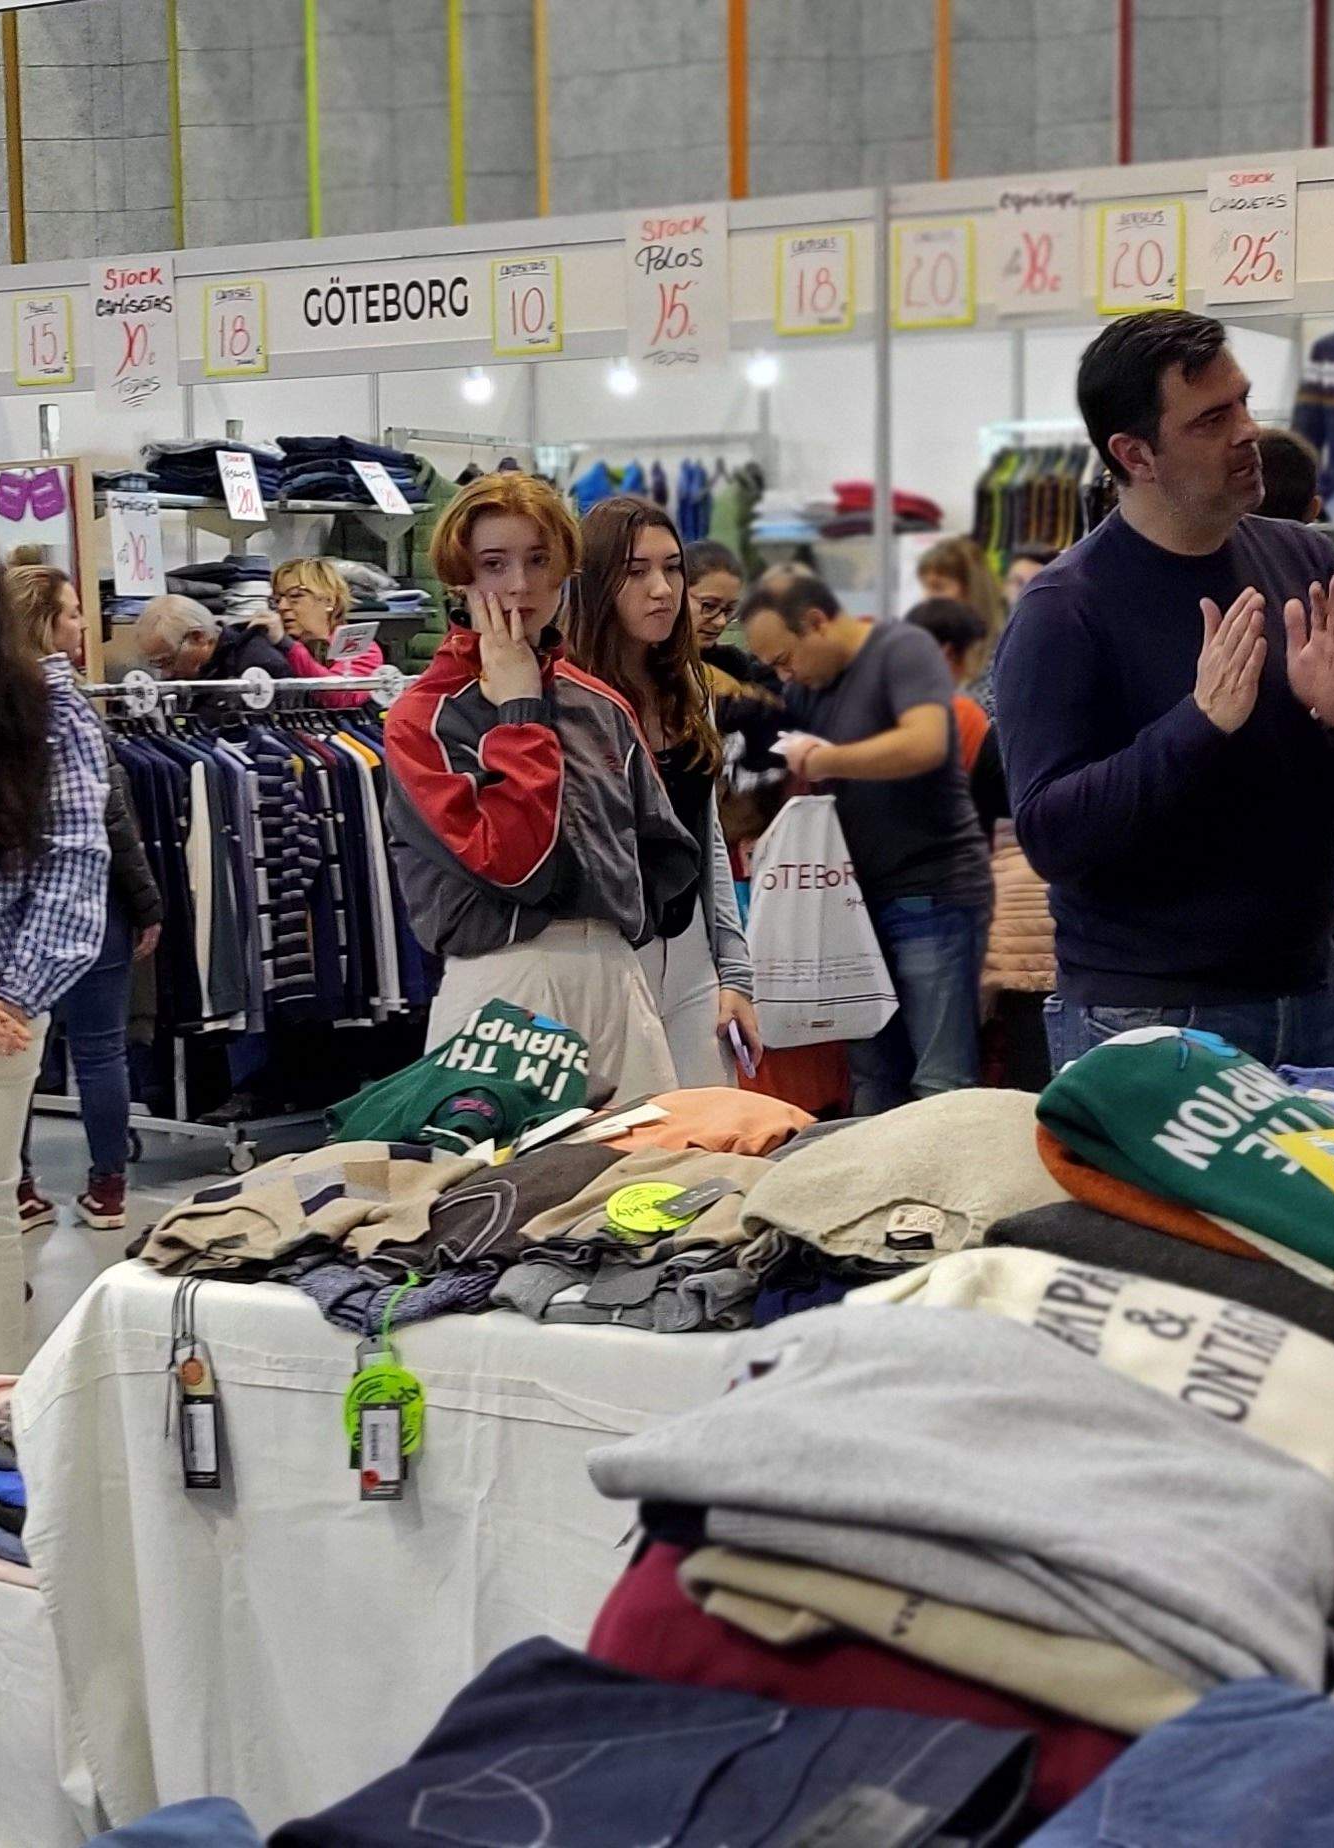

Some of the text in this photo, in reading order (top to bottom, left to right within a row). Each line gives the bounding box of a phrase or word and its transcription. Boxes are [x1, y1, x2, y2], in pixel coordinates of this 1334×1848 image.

[641, 216, 709, 242] STOCK
[635, 245, 704, 275] POLOS
[104, 267, 163, 291] STOCK
[303, 276, 468, 328] GÖTEBORG
[1123, 1306, 1198, 1341] &
